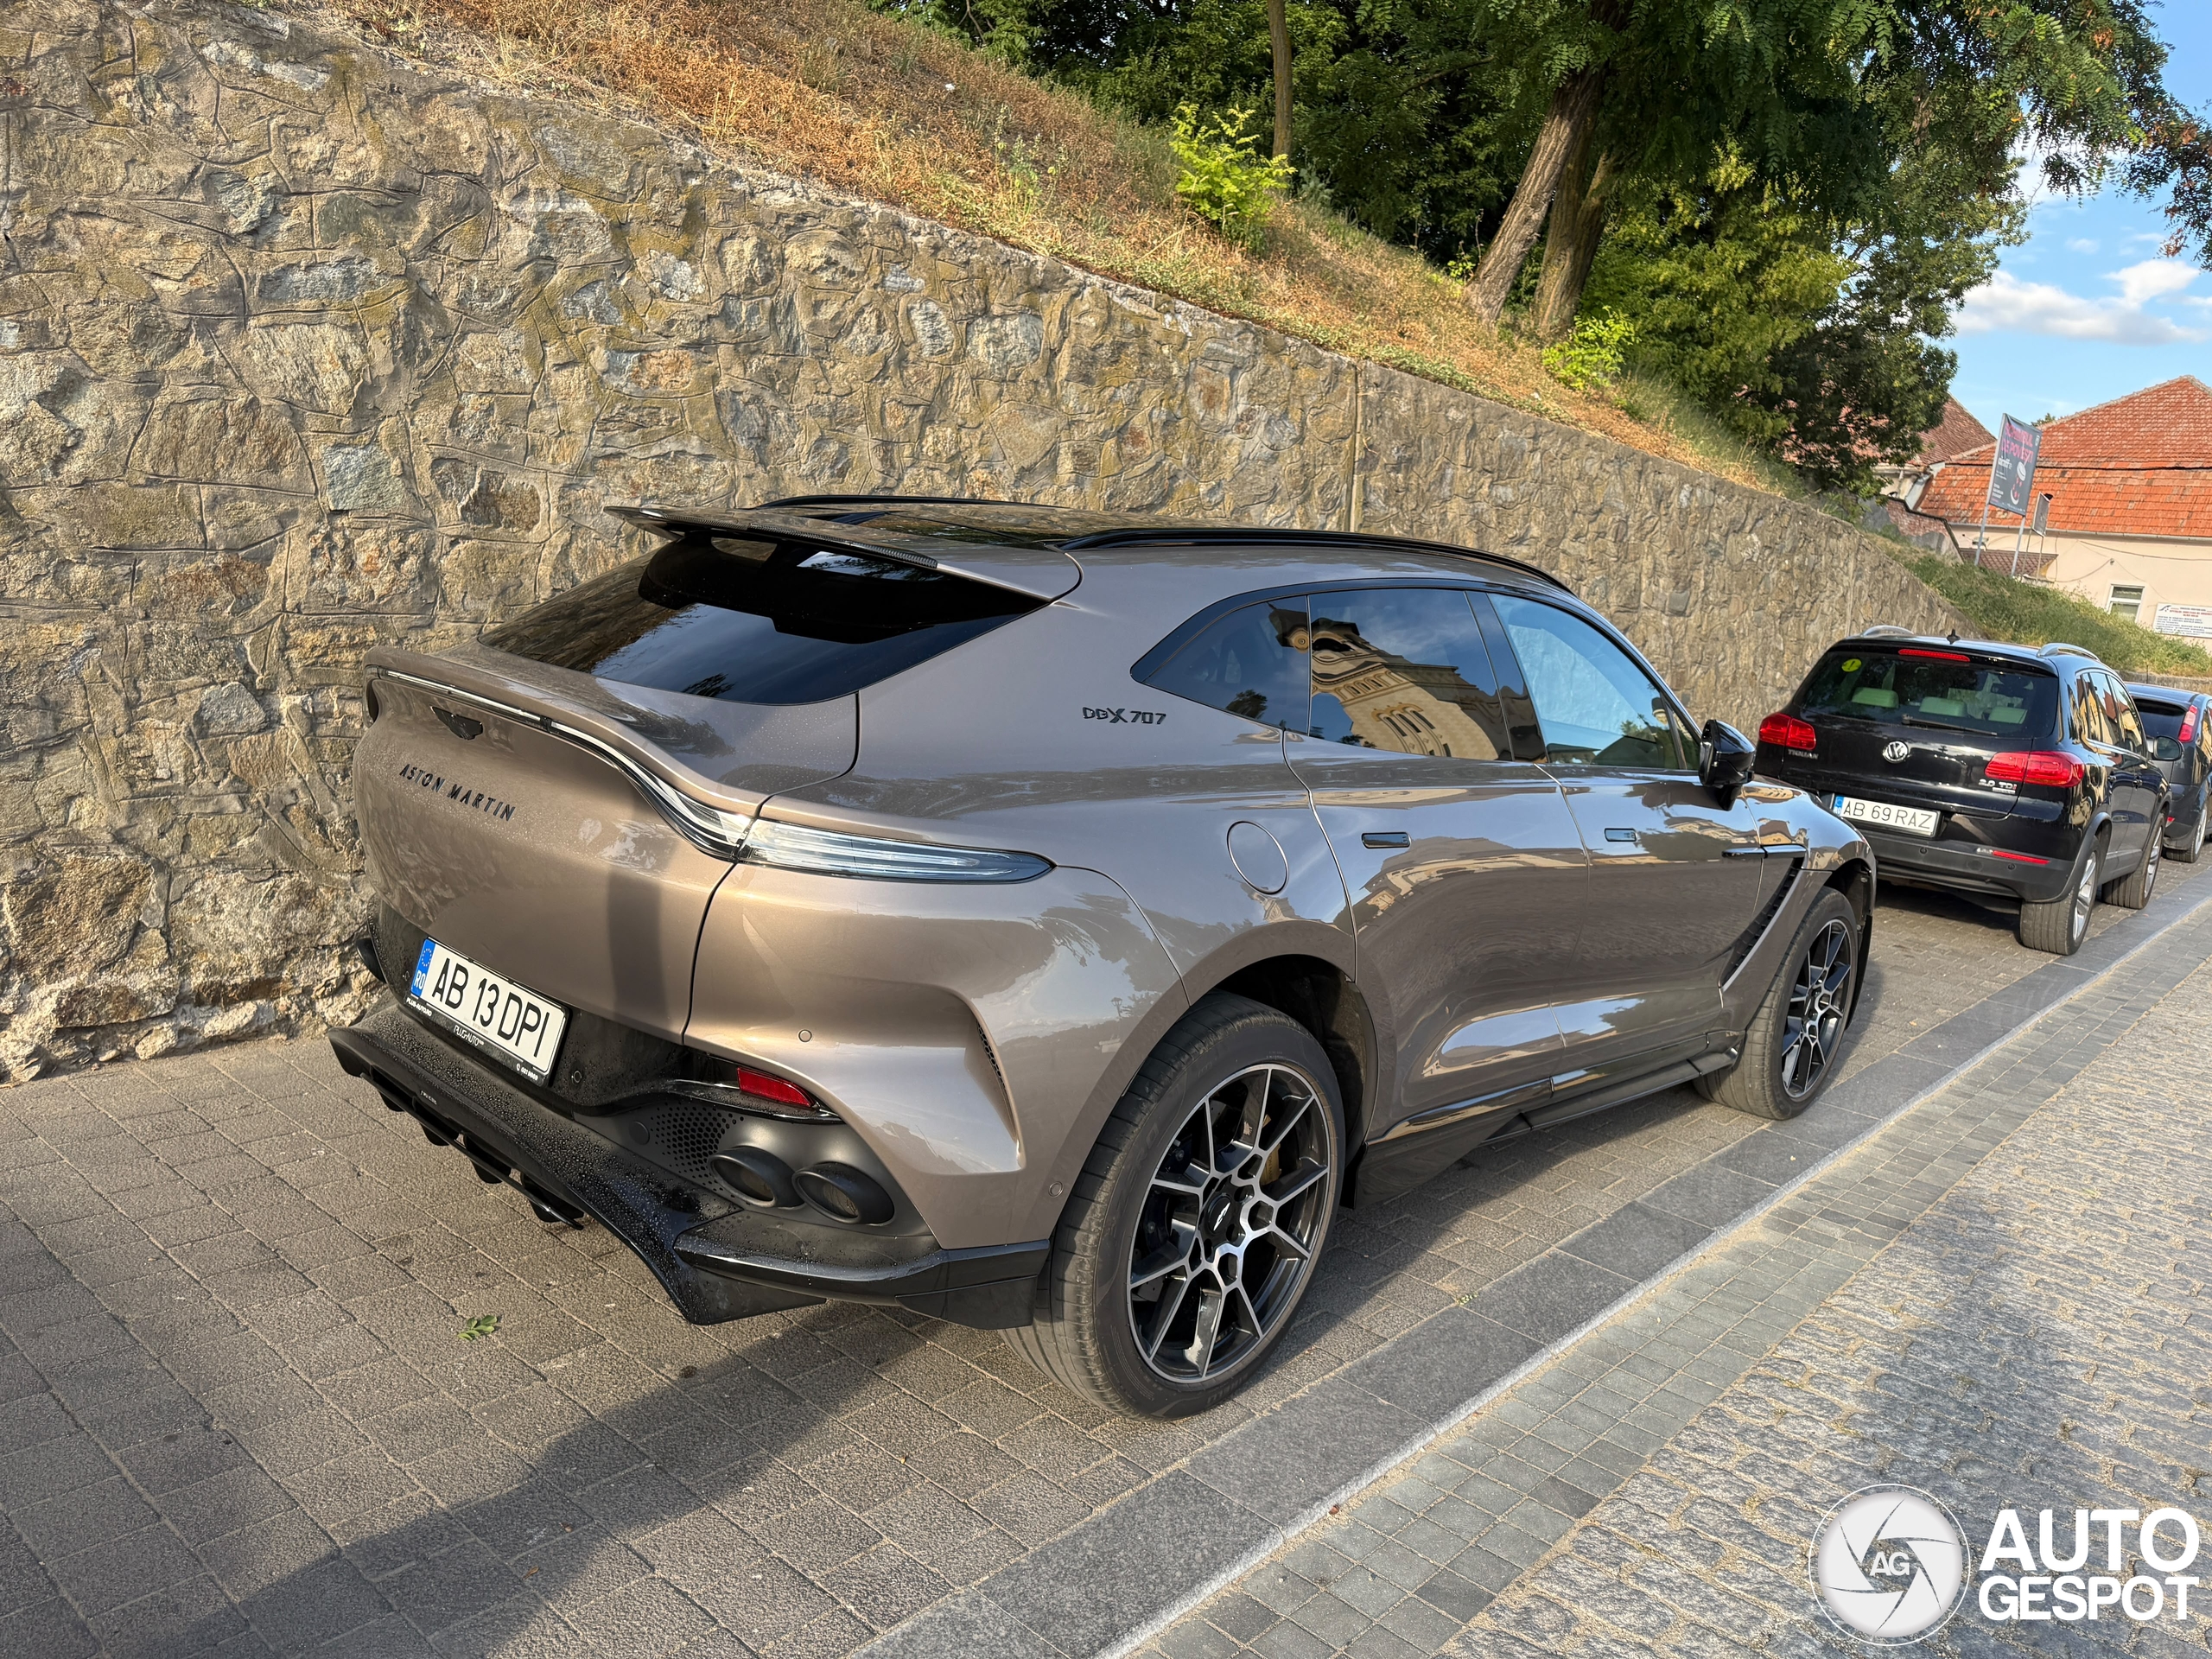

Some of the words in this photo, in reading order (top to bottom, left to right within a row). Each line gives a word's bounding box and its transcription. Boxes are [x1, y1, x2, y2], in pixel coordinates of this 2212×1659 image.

[1082, 706, 1128, 724] DBX
[1129, 710, 1166, 725] 707
[399, 763, 445, 791] ASTON
[448, 784, 517, 823] MARTIN
[1843, 800, 1866, 817] AB
[1872, 805, 1891, 823] 69
[1895, 810, 1934, 830] RAZ
[414, 970, 427, 991] RO
[432, 958, 469, 1009] AB
[472, 978, 499, 1027] 13
[498, 992, 550, 1058] DPI
